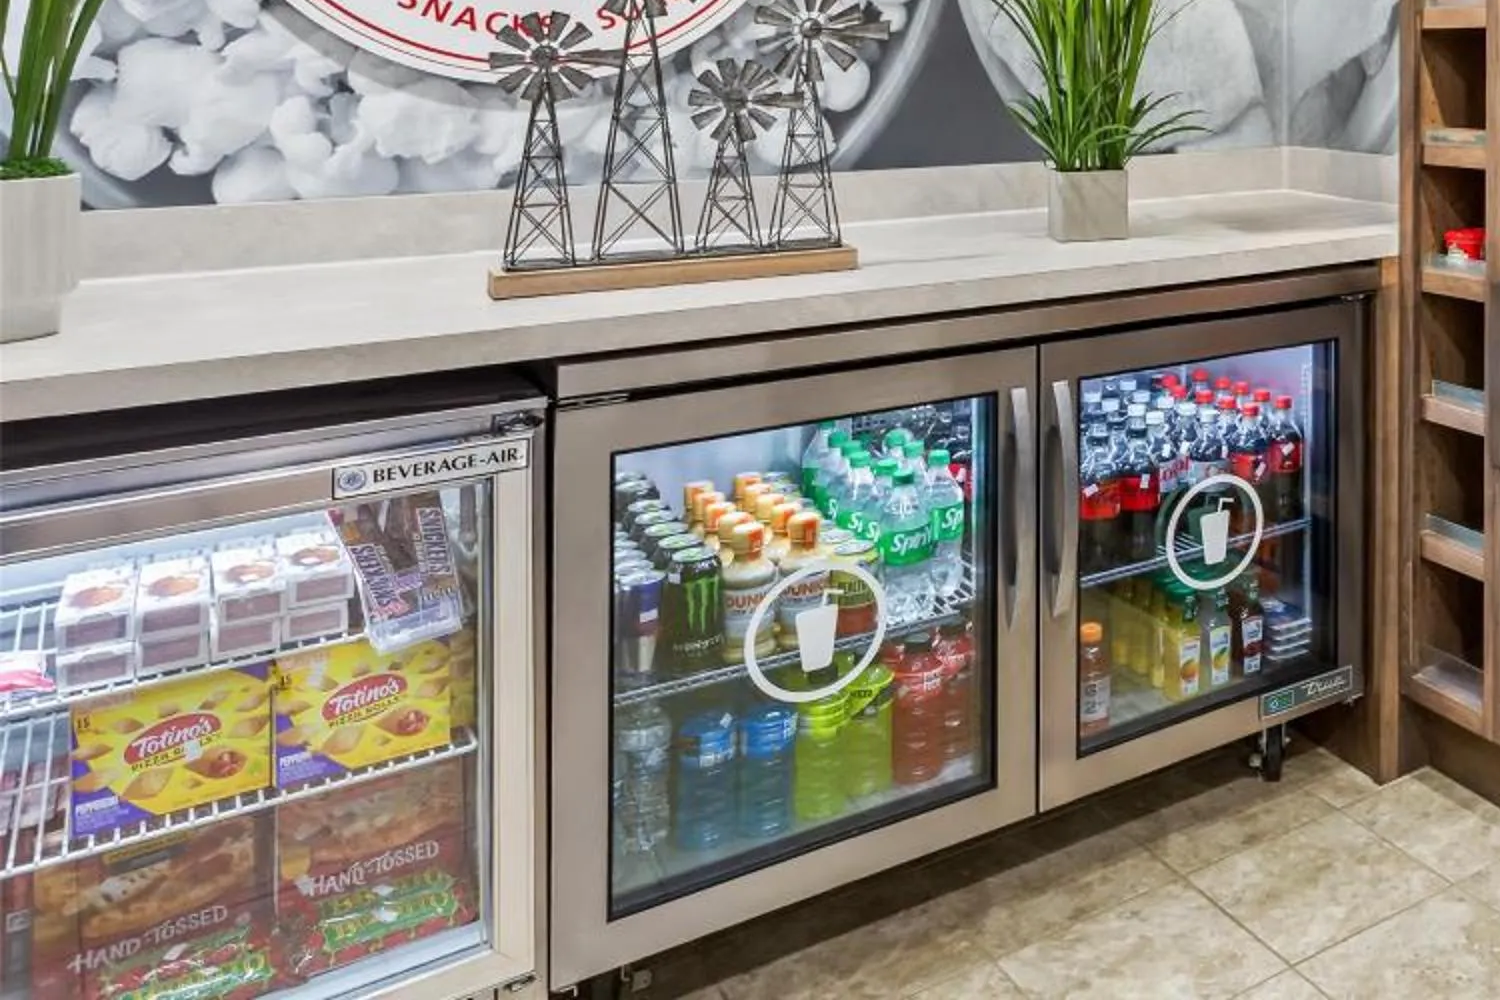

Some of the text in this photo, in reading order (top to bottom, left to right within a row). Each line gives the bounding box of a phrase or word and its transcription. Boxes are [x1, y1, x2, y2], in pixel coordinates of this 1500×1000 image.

[373, 447, 519, 484] BEVERAGE-AIR
[330, 676, 400, 716] Totino's
[132, 716, 214, 758] Totino's
